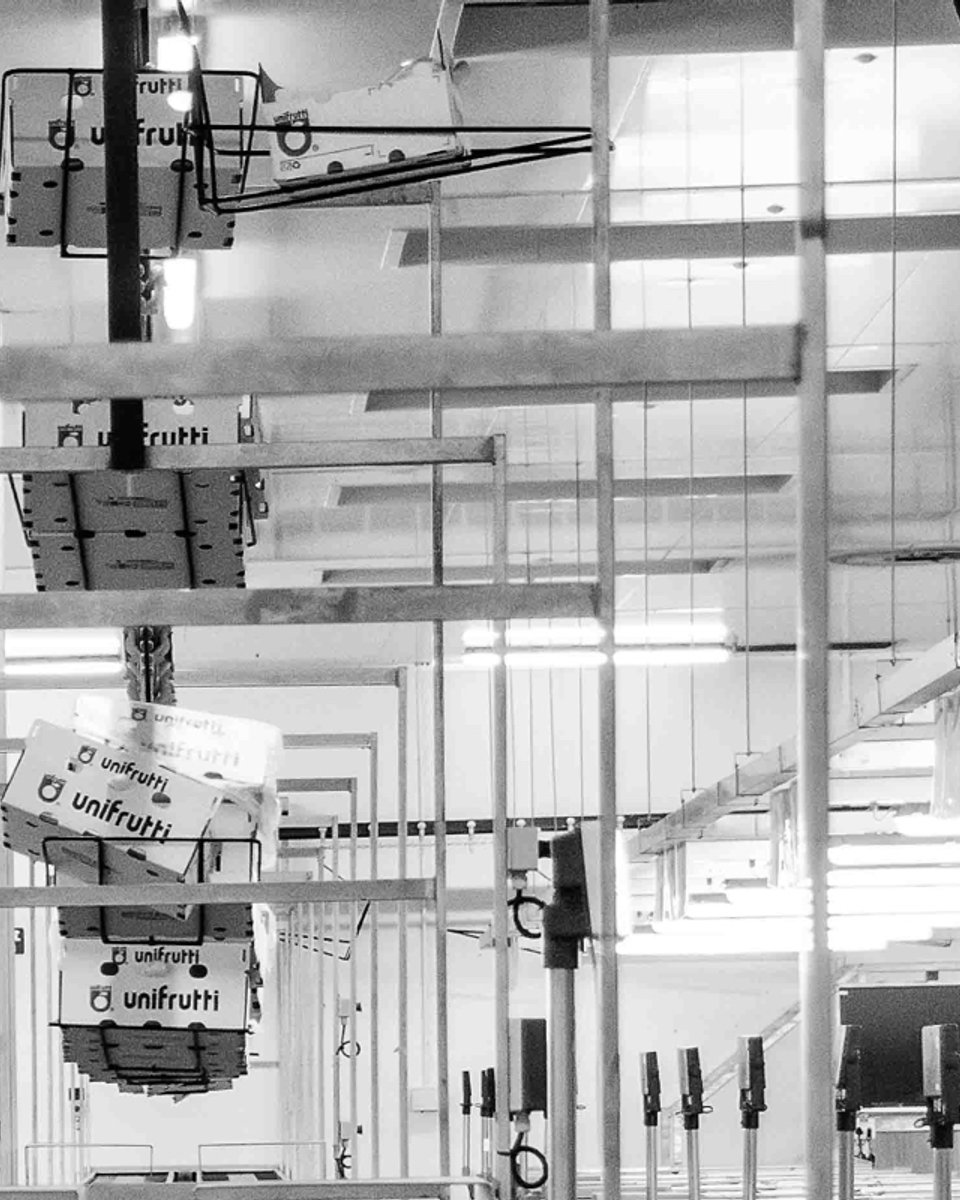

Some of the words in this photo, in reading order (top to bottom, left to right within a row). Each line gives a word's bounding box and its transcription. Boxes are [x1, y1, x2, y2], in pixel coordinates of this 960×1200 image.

[98, 422, 208, 446] urutti
[101, 757, 169, 793] unifrutti
[72, 792, 173, 844] unifrutti
[134, 946, 200, 965] unifrutti
[124, 985, 219, 1012] unifrutti
